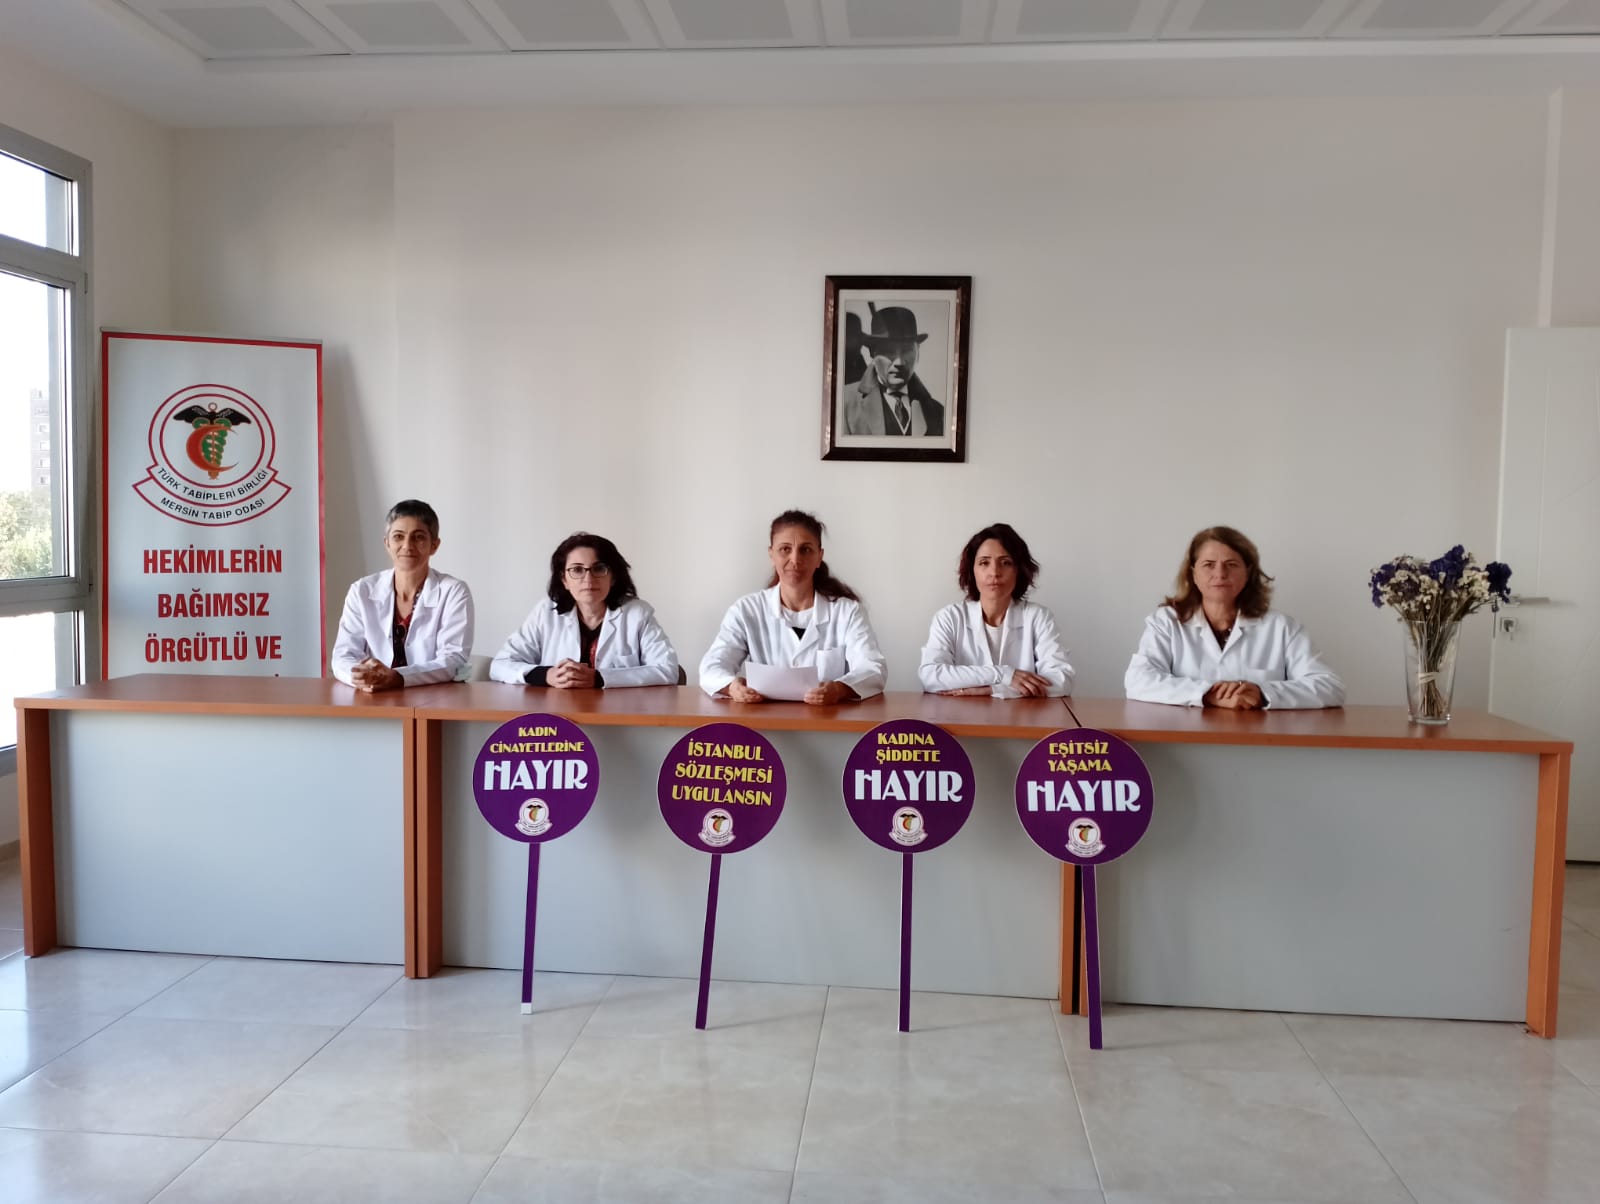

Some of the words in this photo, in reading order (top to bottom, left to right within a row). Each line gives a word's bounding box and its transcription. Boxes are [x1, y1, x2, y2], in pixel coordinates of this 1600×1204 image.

[157, 468, 179, 490] TÜRK
[183, 486, 236, 501] TABİPLERİ
[238, 469, 268, 494] BİRLİĞİ
[160, 497, 199, 518] MERSİN
[202, 510, 232, 519] TABİP
[235, 498, 265, 516] ODASI
[143, 544, 282, 574] HEKİMLERİN
[158, 587, 270, 618] BAĞIMSIZ
[145, 631, 248, 663] ÖRGÜTLÜ
[255, 636, 282, 660] VE
[518, 726, 557, 737] KADIN
[877, 733, 935, 745] KADINA
[489, 740, 584, 753] CİNAYETLERİNE
[688, 738, 764, 761] İSTANBUL
[876, 747, 941, 764] ŞİDDETE
[1049, 739, 1109, 758] EŞİTSİZ
[483, 759, 588, 790] HAYIR
[675, 760, 773, 785] SÖZLEŞMESİ
[1048, 759, 1112, 775] YAŞAMA
[672, 785, 772, 806] UYGULANSIN
[855, 769, 963, 802] HAYIR
[1027, 780, 1141, 812] HAYIR
